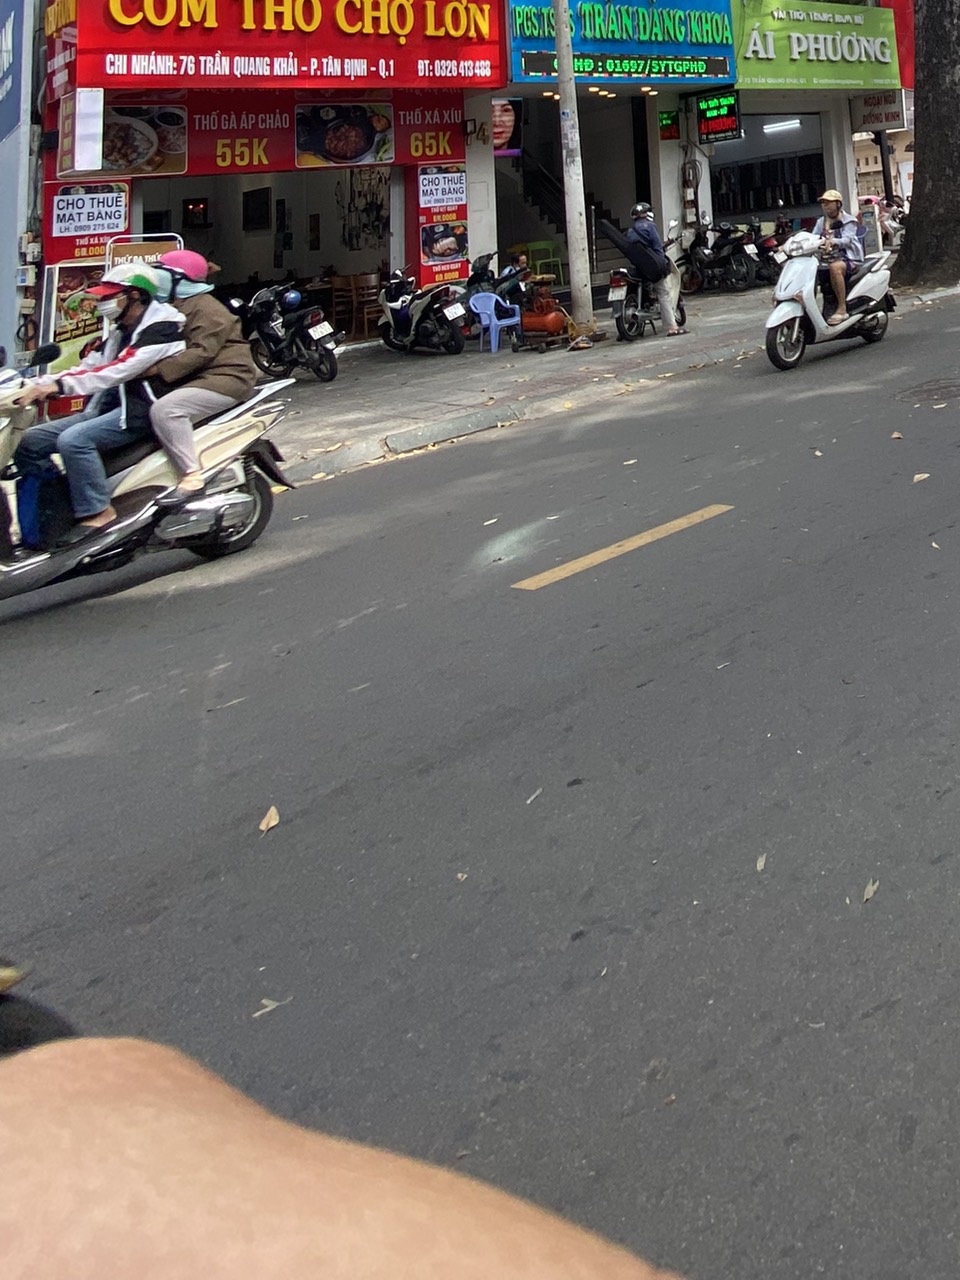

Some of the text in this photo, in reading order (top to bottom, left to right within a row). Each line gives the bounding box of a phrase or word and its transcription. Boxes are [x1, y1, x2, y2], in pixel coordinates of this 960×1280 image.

[687, 8, 733, 45] KHOA
[744, 22, 893, 64] ÁI PHƯƠNG
[105, 54, 127, 75] CHI
[131, 51, 178, 75] NHÁNH:
[179, 56, 196, 76] 76
[199, 50, 231, 76] TRẦN
[234, 56, 271, 79] QUANG
[273, 51, 299, 77] KHẢI
[344, 58, 368, 80] ĐỊNH
[417, 59, 433, 77] ĐT:
[434, 59, 458, 77] 0326
[193, 109, 290, 130] THỐ GÀ ÁP CHẢO
[399, 106, 462, 125] THỐ XÁ XÍU
[216, 137, 269, 167] 55K
[409, 130, 452, 157] 65K
[421, 173, 465, 187] CHO THUÊ
[56, 192, 123, 211] CHO THUÊ
